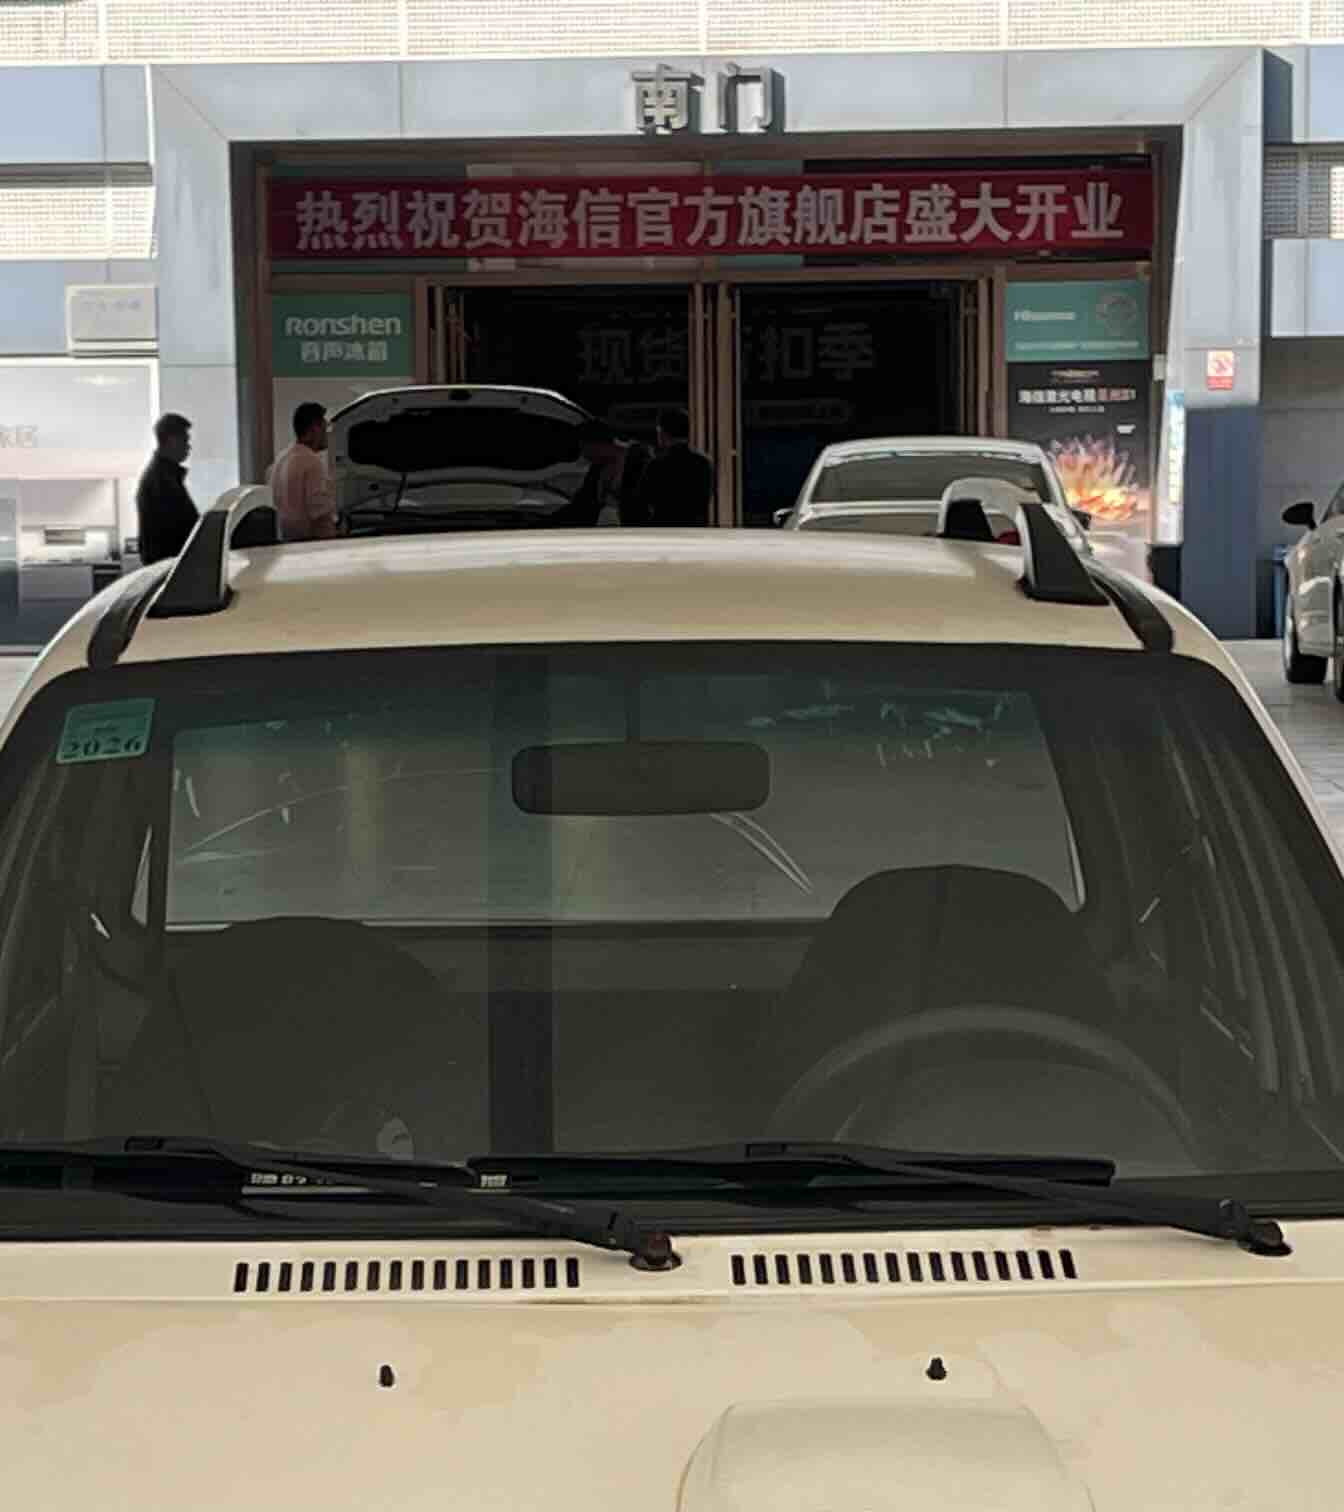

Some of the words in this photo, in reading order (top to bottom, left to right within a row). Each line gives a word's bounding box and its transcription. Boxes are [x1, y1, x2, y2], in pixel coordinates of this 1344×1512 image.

[631, 63, 774, 132] 南门
[296, 182, 1124, 250] 热烈祝贺海信官方旗舰店盛大开业
[285, 314, 401, 336] Ronshen
[62, 735, 143, 758] 2026
